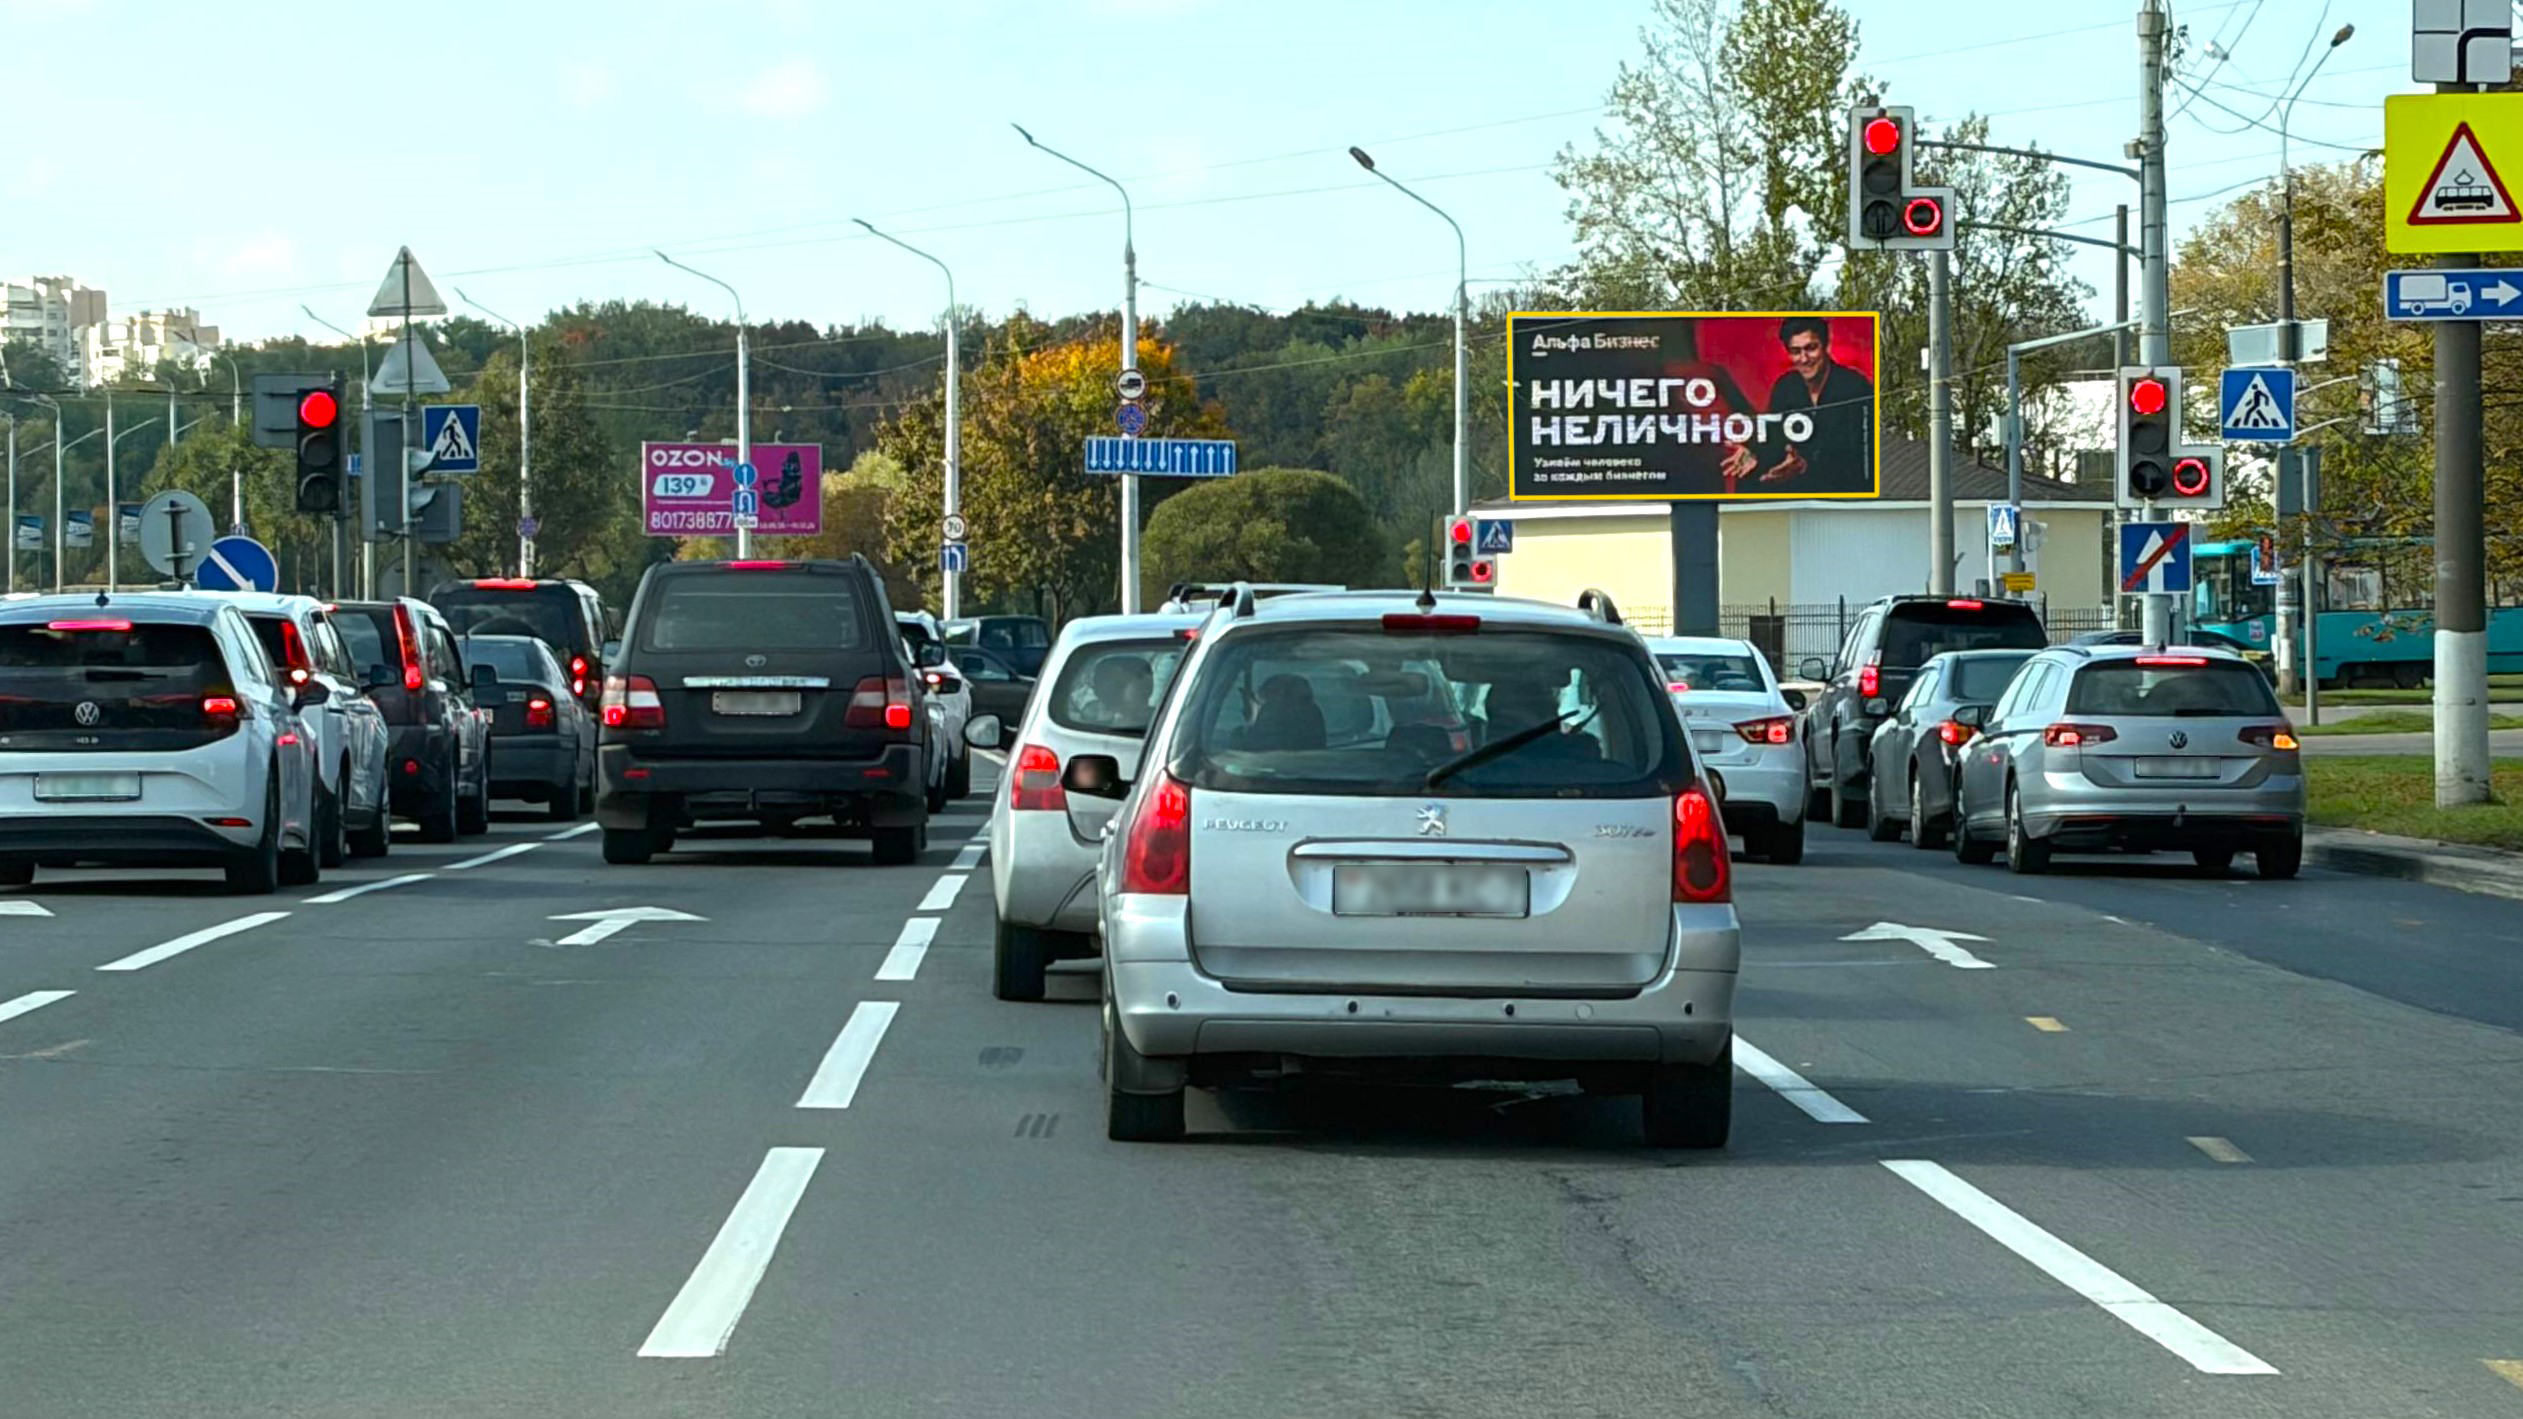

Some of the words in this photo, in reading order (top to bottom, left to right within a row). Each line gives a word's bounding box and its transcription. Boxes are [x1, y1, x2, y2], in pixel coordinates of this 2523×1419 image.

[1532, 333, 1591, 355] Альфа
[1593, 332, 1660, 349] Бизнес
[1530, 377, 1717, 409] НИЧЕГО
[1530, 412, 1815, 446] НЕЛИЧНОГО
[663, 476, 696, 494] 139
[1203, 818, 1290, 832] PEUGEOT
